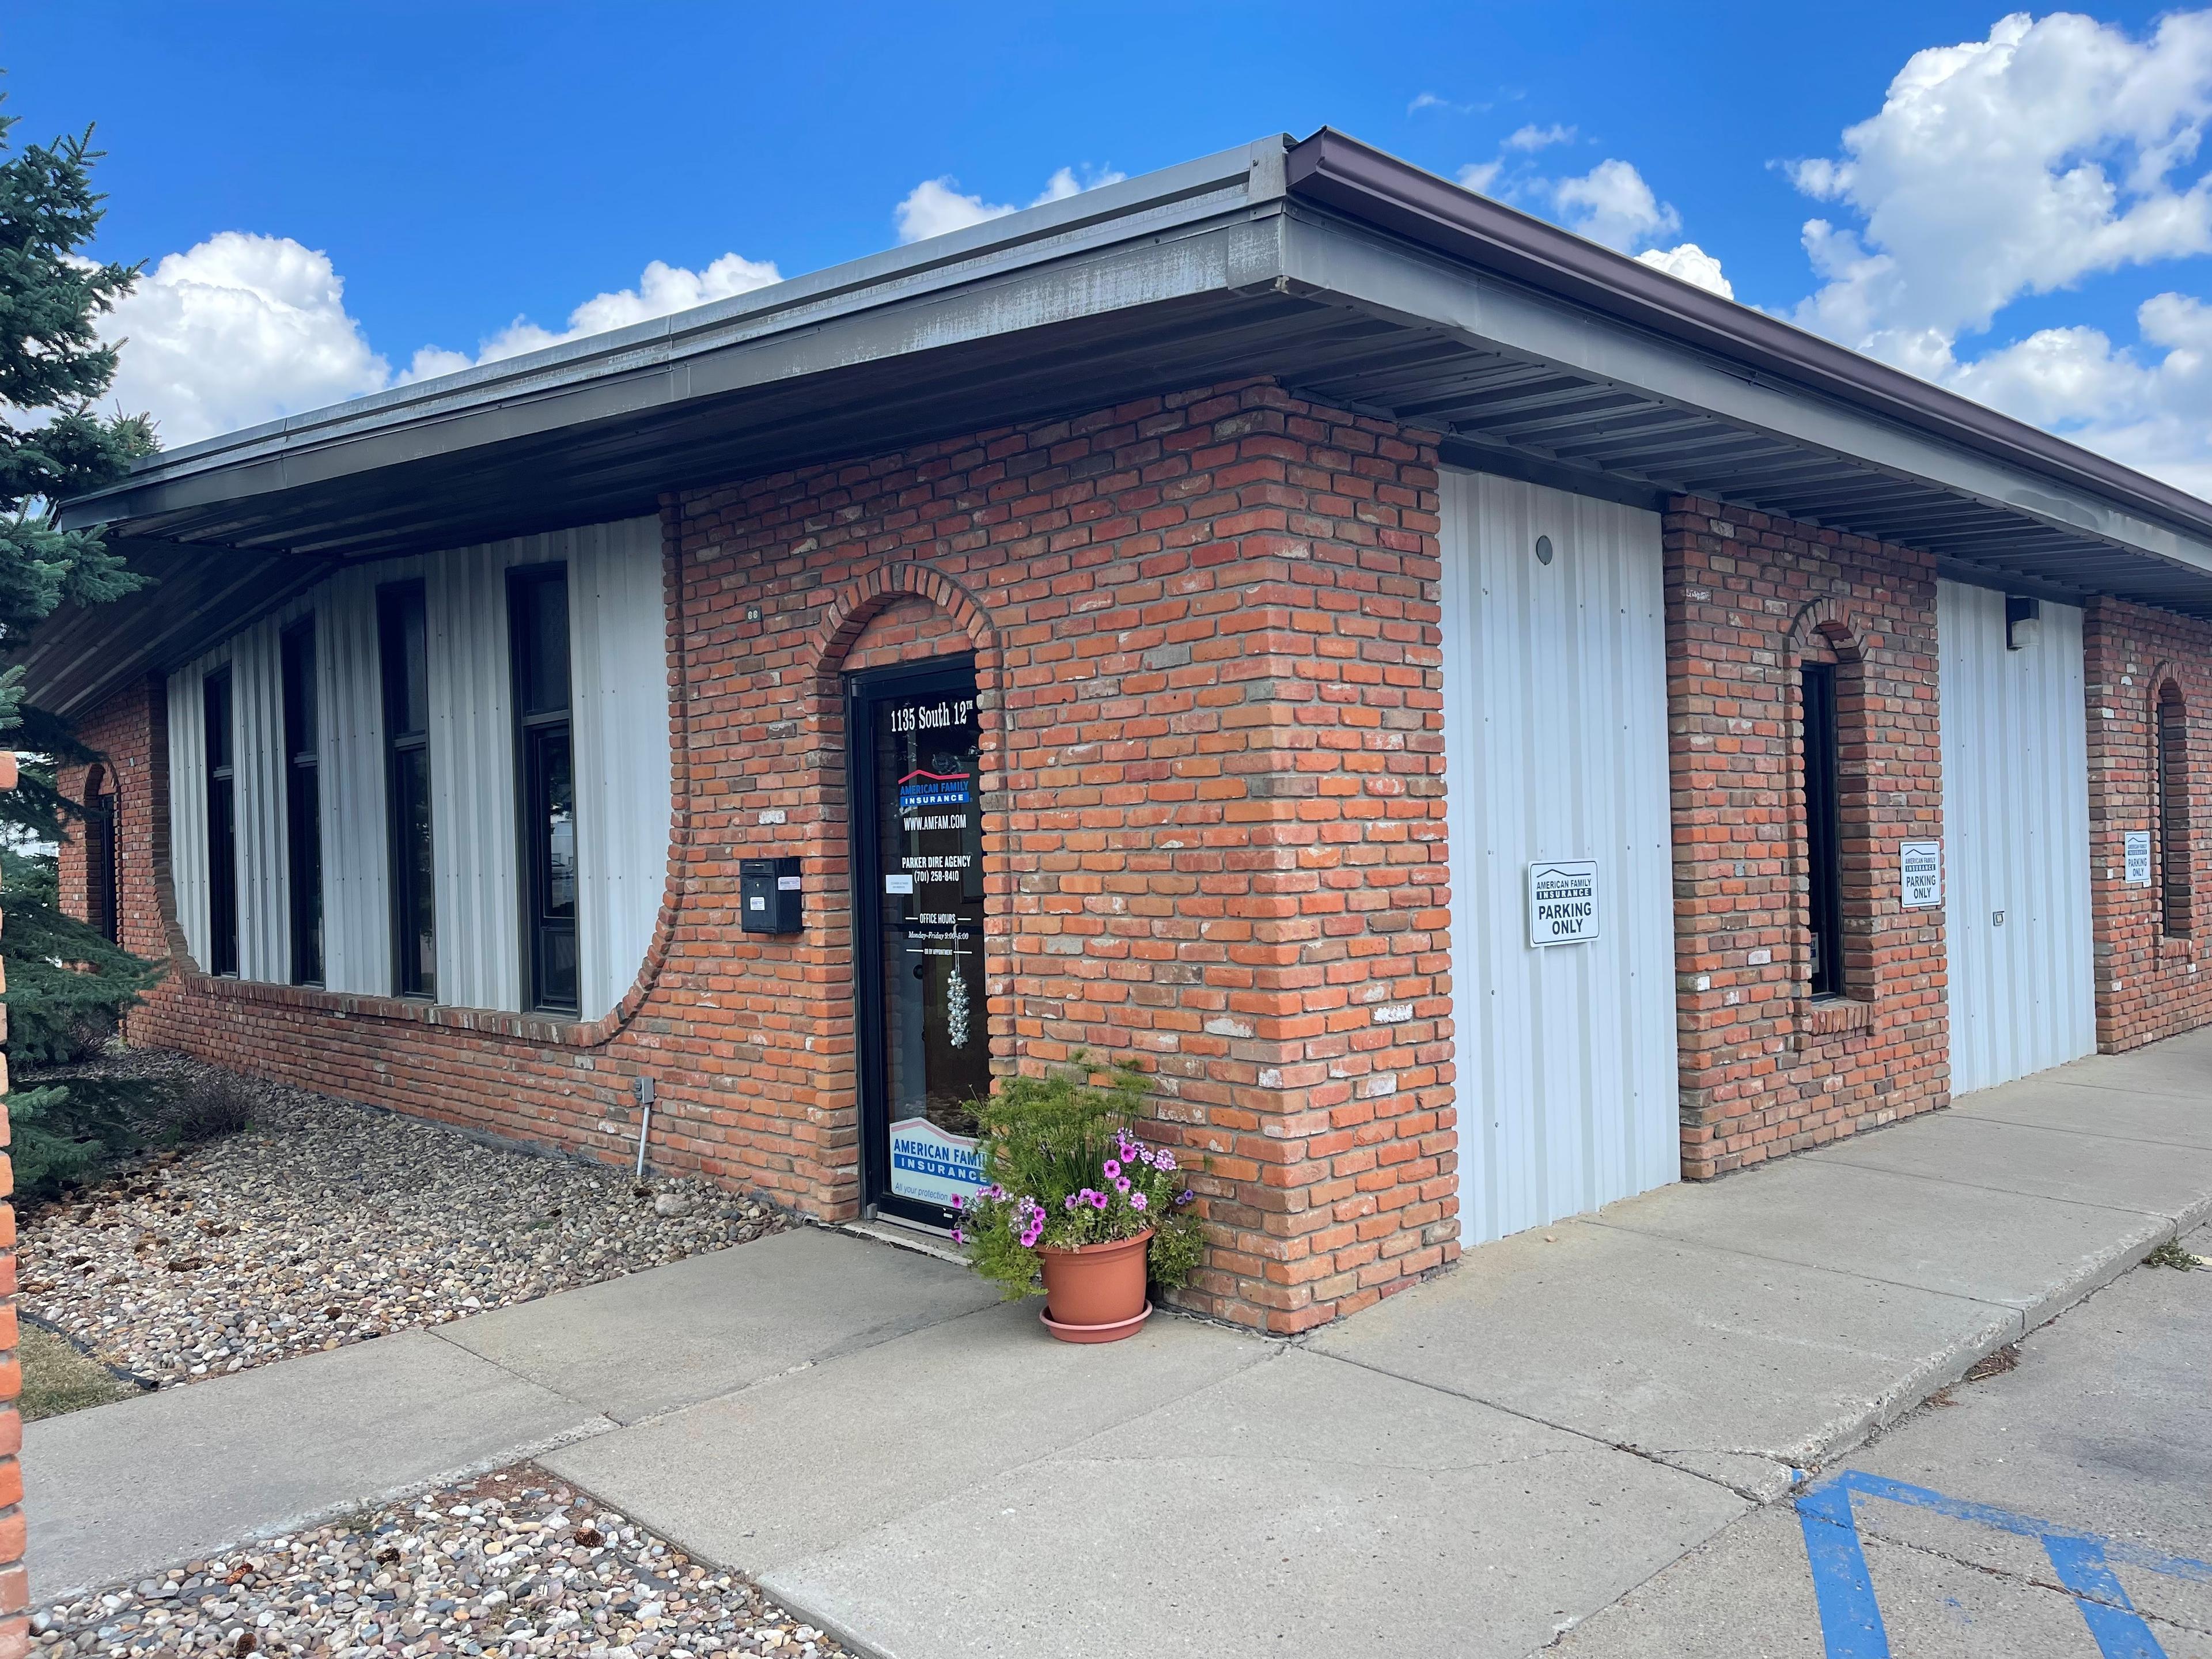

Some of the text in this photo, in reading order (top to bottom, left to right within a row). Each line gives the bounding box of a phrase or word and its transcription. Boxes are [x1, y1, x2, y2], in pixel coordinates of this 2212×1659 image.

[891, 707, 915, 732] 1135
[919, 702, 950, 729] South
[900, 781, 968, 795] AMERICAN FAMILY
[905, 794, 964, 804] INSURANCE
[904, 814, 967, 831] WWW.AMFAM.COM
[902, 855, 971, 869] PARKER DIRE AGENCY
[2128, 858, 2147, 868] PARKING
[914, 870, 959, 883] (701) 258-8410
[2133, 868, 2143, 877] ONLY
[1536, 878, 1592, 890] AMERICAN FAMILY
[1906, 875, 1936, 887] PARKING
[1539, 889, 1589, 899] INSURANCE
[1914, 887, 1931, 899] ONLY
[1539, 902, 1592, 920] PARKING
[919, 913, 956, 924] OFFICE HOURS
[1552, 919, 1584, 935] ONLY
[894, 1138, 949, 1161] AMERICAN
[904, 1185, 917, 1194] your
[918, 1188, 948, 1200] protection
